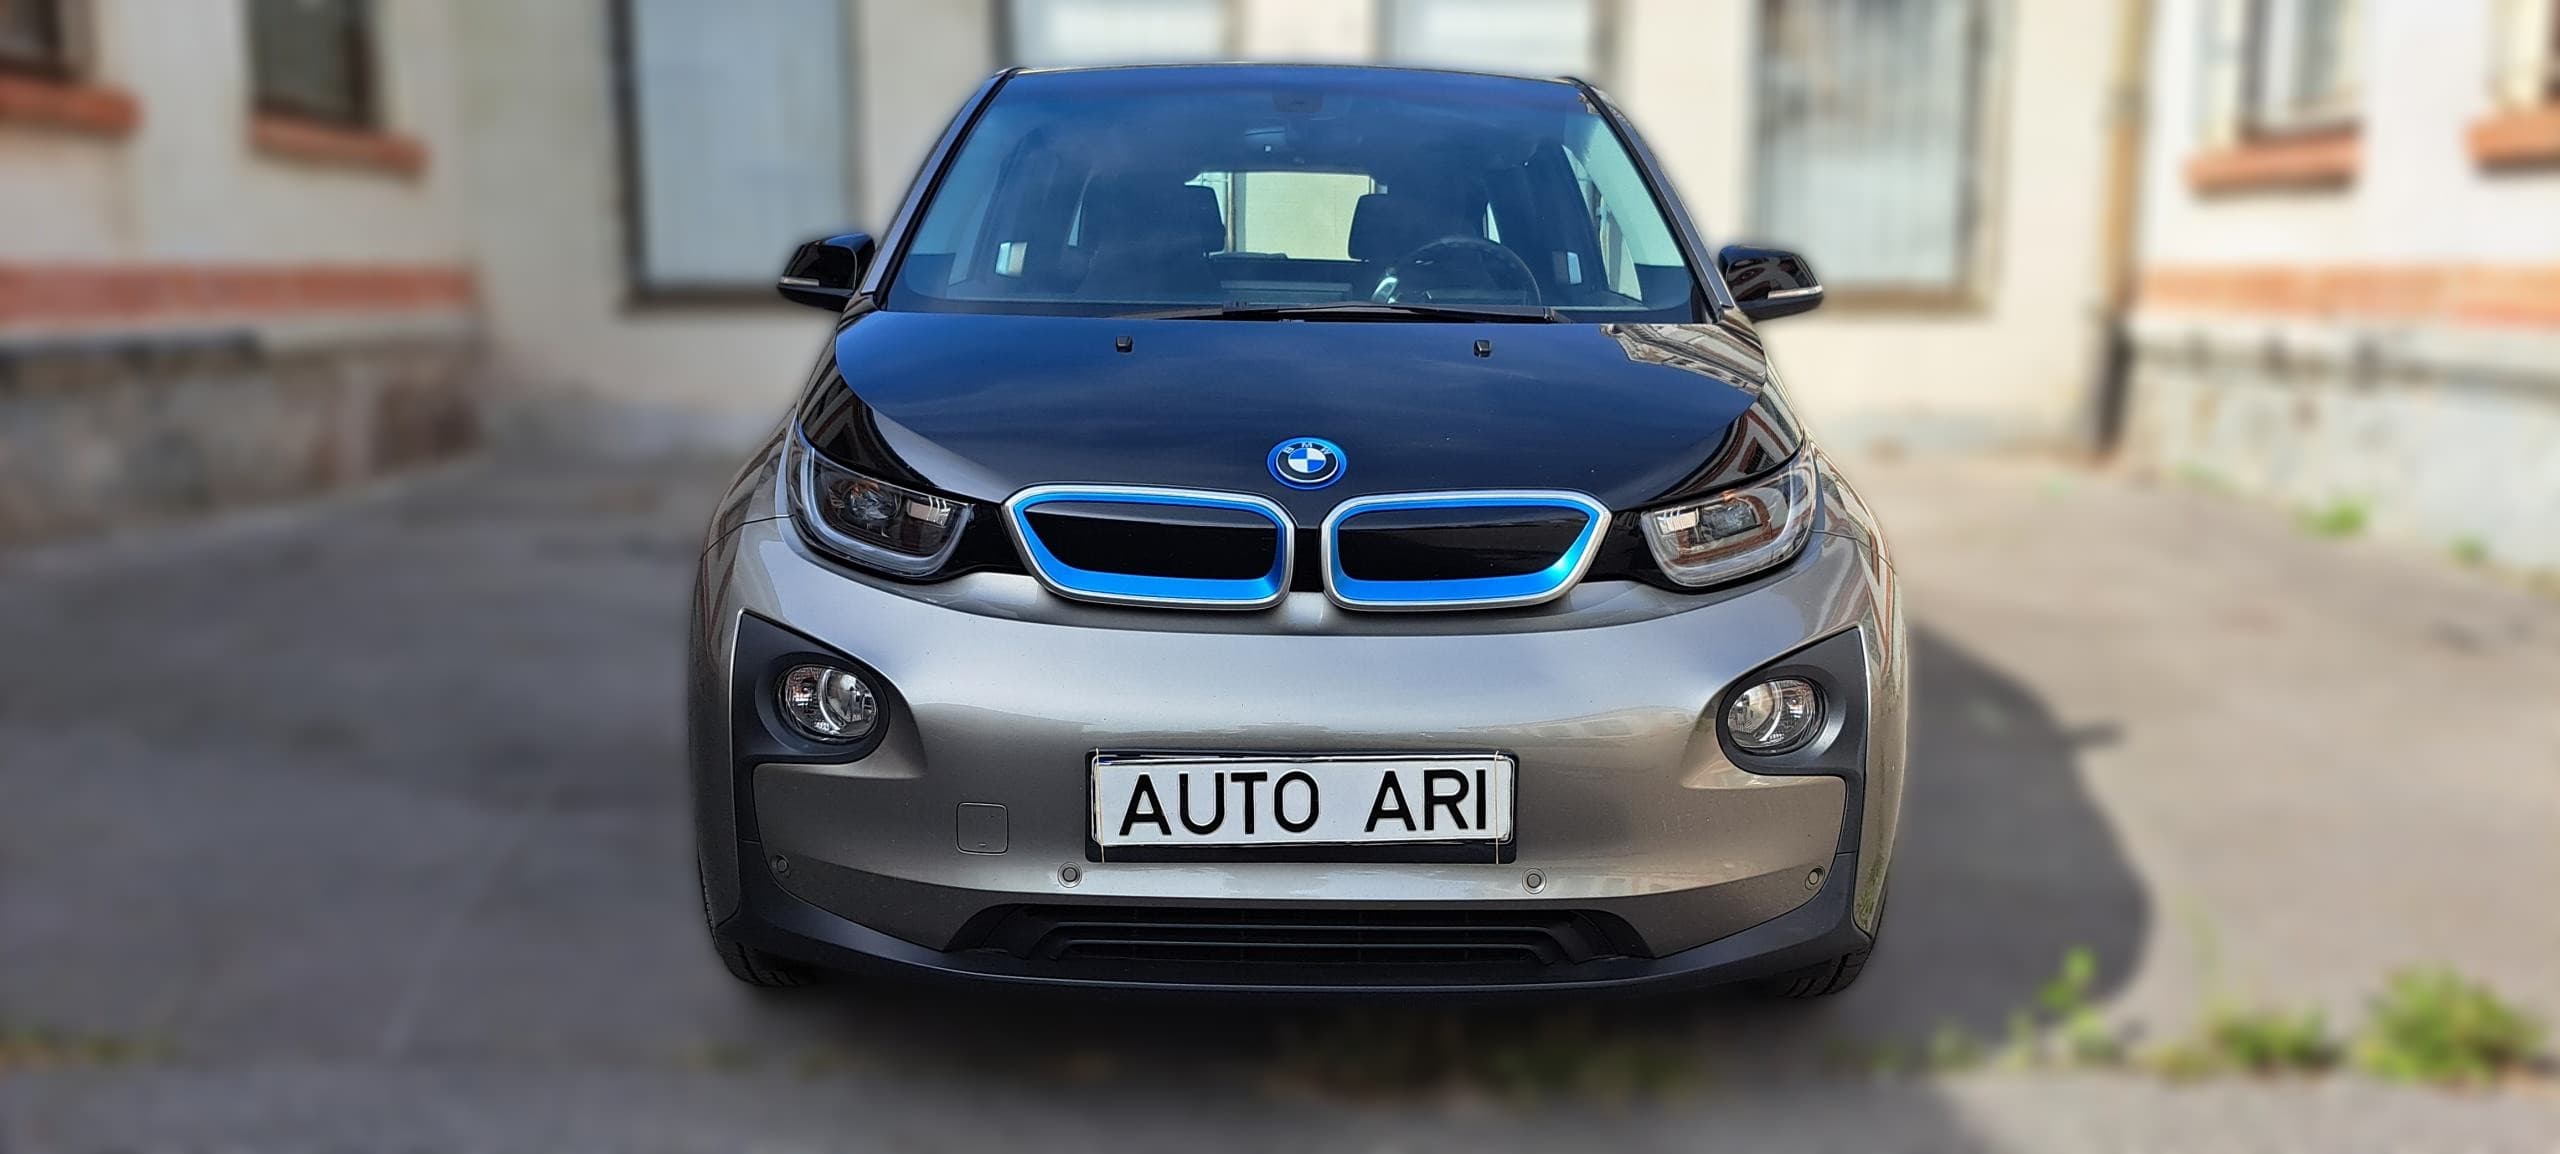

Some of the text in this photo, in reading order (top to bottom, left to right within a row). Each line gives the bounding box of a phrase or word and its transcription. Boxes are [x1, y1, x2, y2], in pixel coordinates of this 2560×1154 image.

[1281, 442, 1333, 455] BMW
[1119, 768, 1487, 836] AUTO ARI
